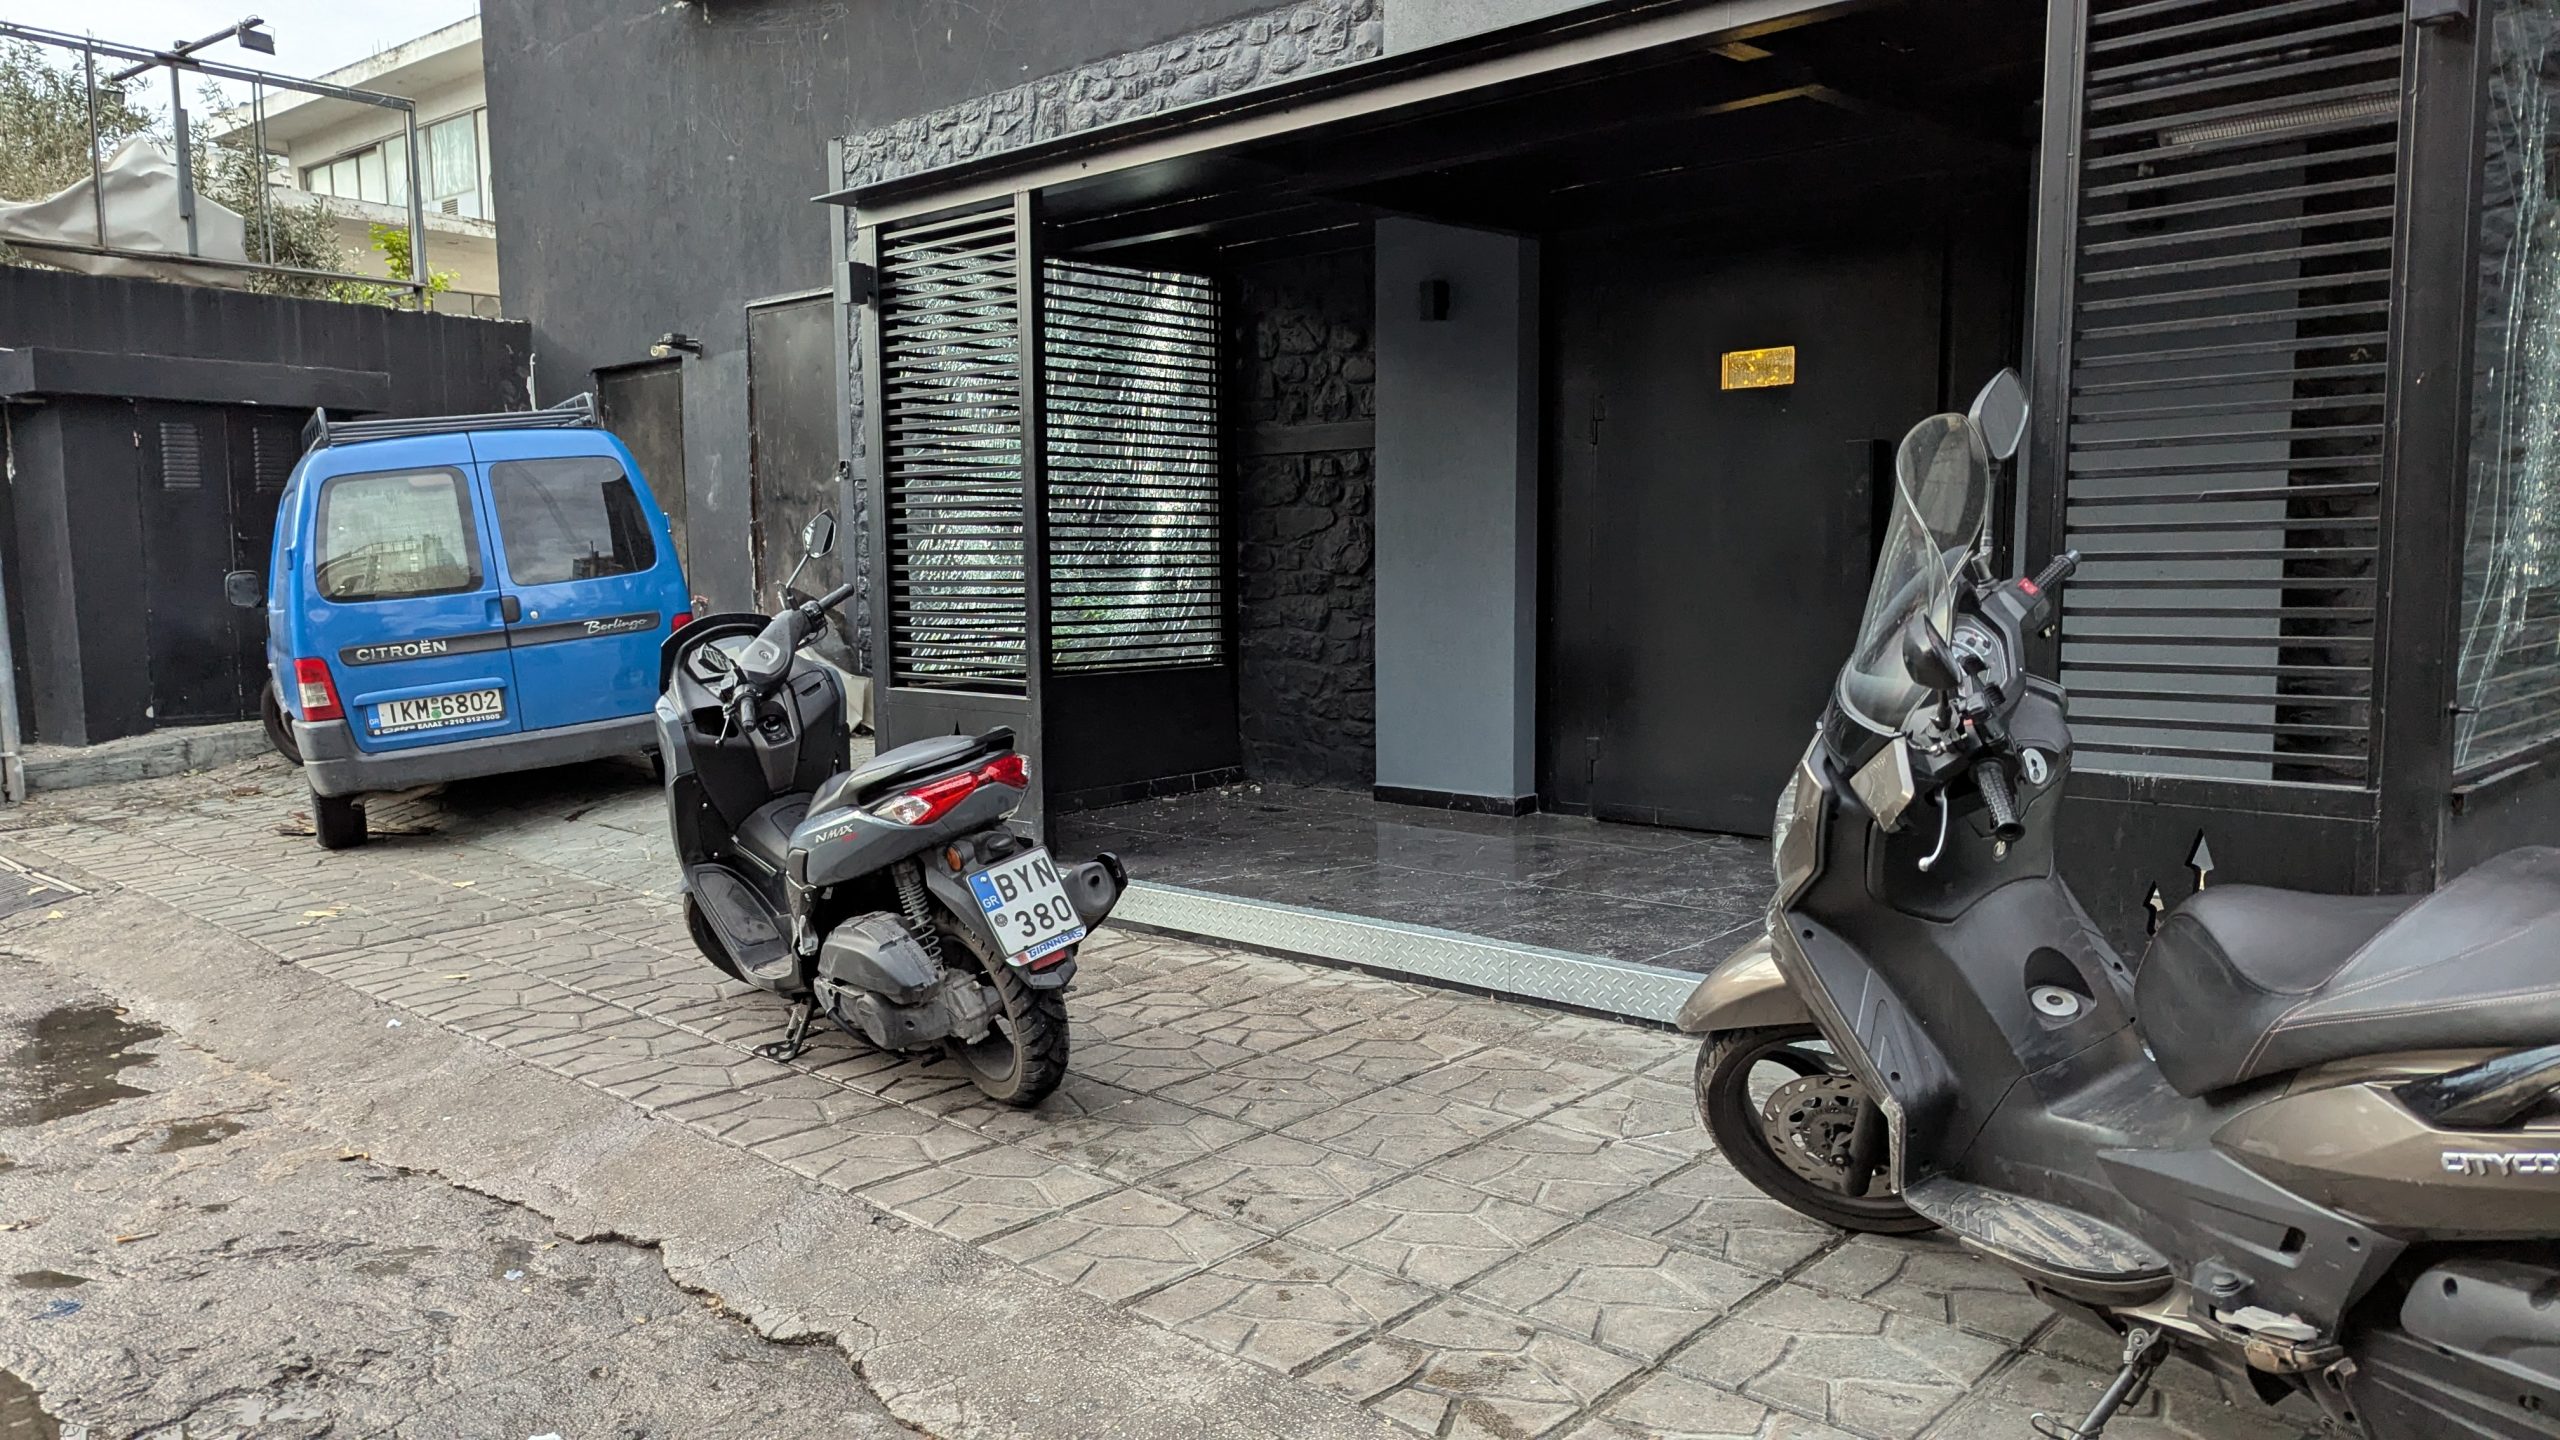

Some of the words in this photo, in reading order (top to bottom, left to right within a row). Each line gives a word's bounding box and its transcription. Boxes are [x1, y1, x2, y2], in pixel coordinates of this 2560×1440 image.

[584, 617, 648, 635] Berlingo
[355, 639, 448, 662] CITROËN
[368, 718, 380, 726] GR
[815, 823, 853, 844] NMAX
[994, 857, 1056, 903] BYN
[982, 895, 1000, 909] GR
[1015, 895, 1072, 937] 380
[2441, 1152, 2560, 1177] CITYCO
